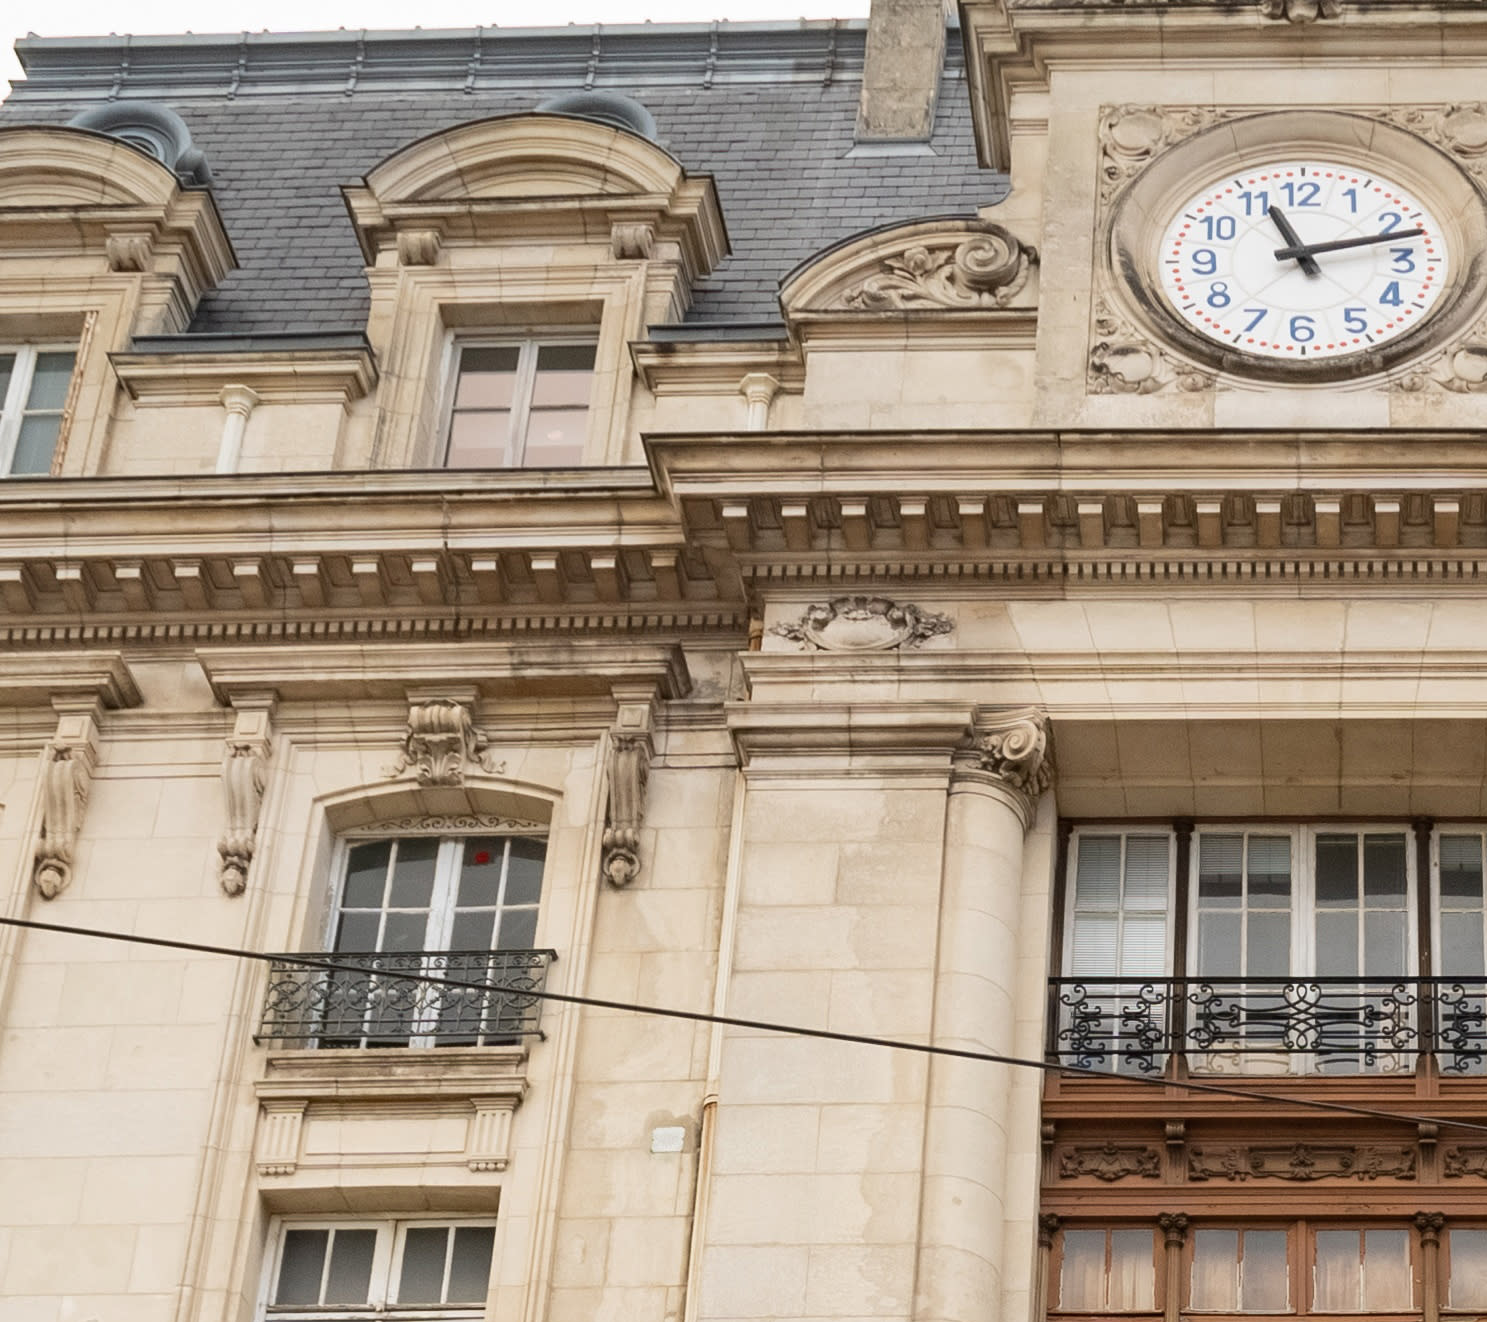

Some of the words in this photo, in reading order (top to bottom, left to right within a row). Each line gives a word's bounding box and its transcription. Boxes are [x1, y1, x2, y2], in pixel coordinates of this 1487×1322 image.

[1237, 191, 1268, 215] 11
[1280, 182, 1321, 206] 12
[1342, 188, 1357, 212] 1
[1199, 215, 1236, 240] 10
[1378, 212, 1402, 234] 2
[1192, 249, 1217, 274] 9
[1389, 248, 1415, 272] 3
[1207, 282, 1231, 307] 8
[1379, 281, 1403, 306] 4
[1244, 309, 1267, 332] 7
[1289, 316, 1315, 341] 6
[1344, 308, 1367, 333] 5
